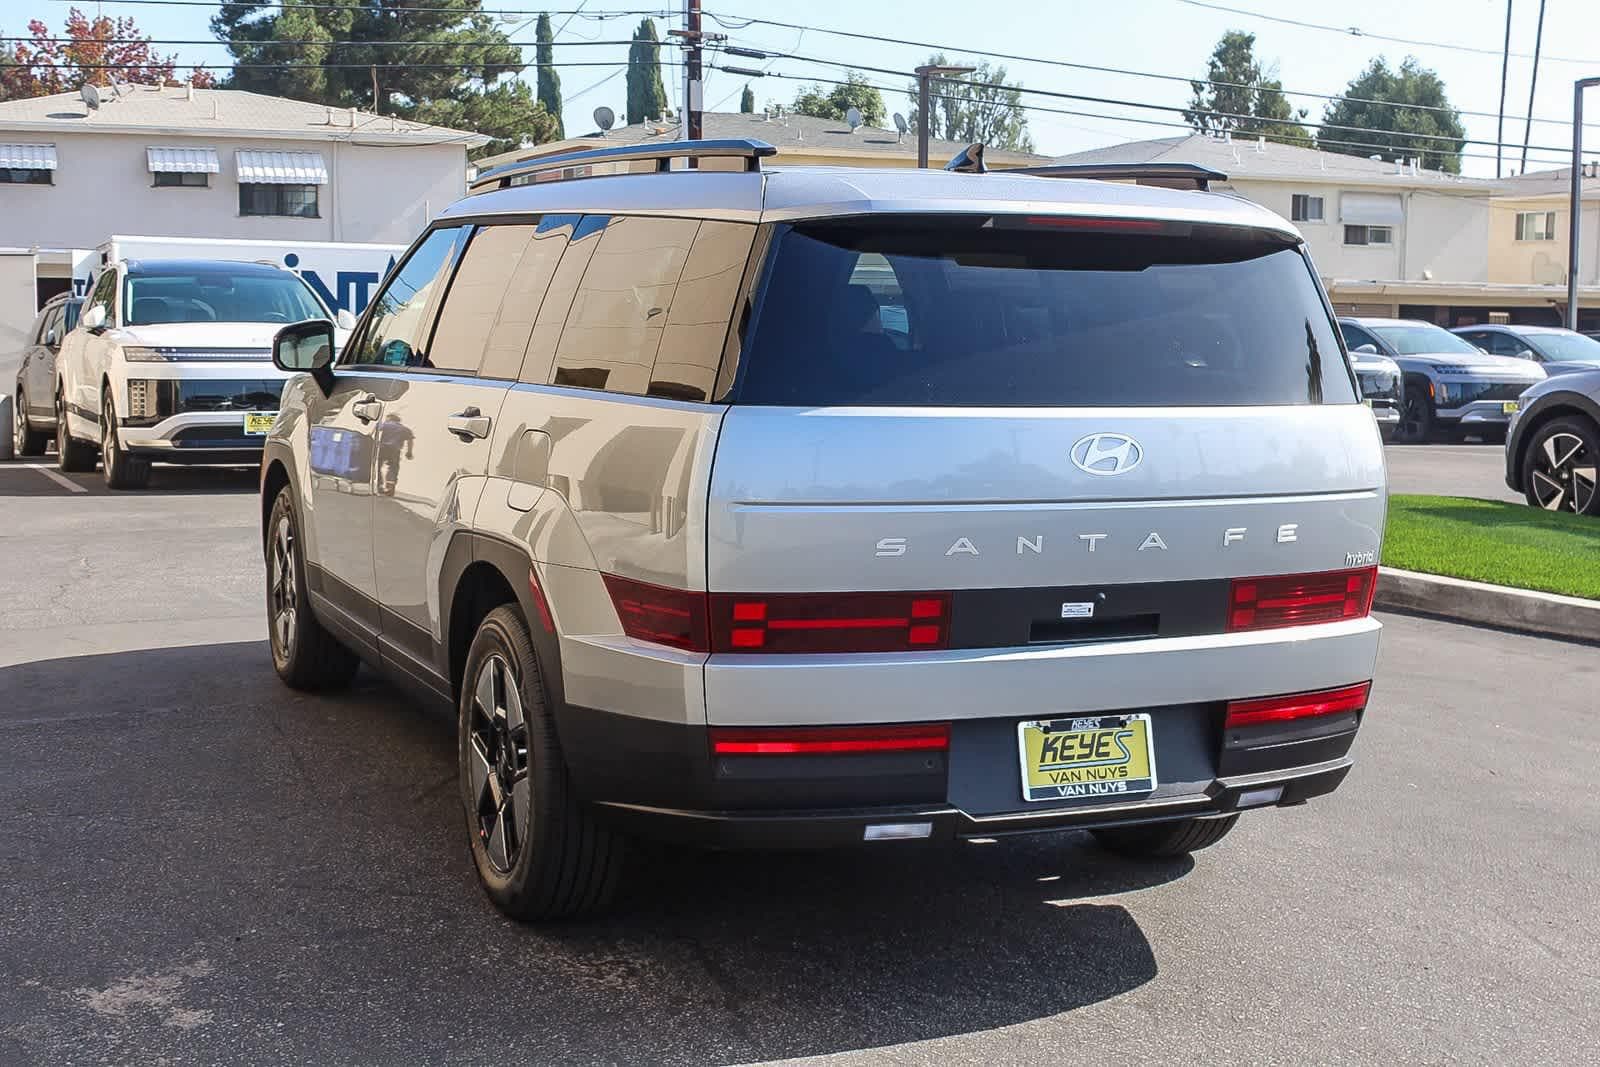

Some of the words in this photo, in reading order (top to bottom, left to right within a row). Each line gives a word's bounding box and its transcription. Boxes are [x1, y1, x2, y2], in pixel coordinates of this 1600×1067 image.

[251, 416, 275, 425] KEYE
[875, 532, 1168, 556] SANTA
[1223, 523, 1299, 546] FE
[1344, 550, 1374, 567] hybrid
[1071, 719, 1101, 730] KEYES
[1040, 730, 1134, 763] KEYES
[1049, 772, 1081, 784] VAN
[1086, 766, 1128, 781] NUYS
[1057, 784, 1085, 796] VAN
[1089, 781, 1128, 795] NUYS
